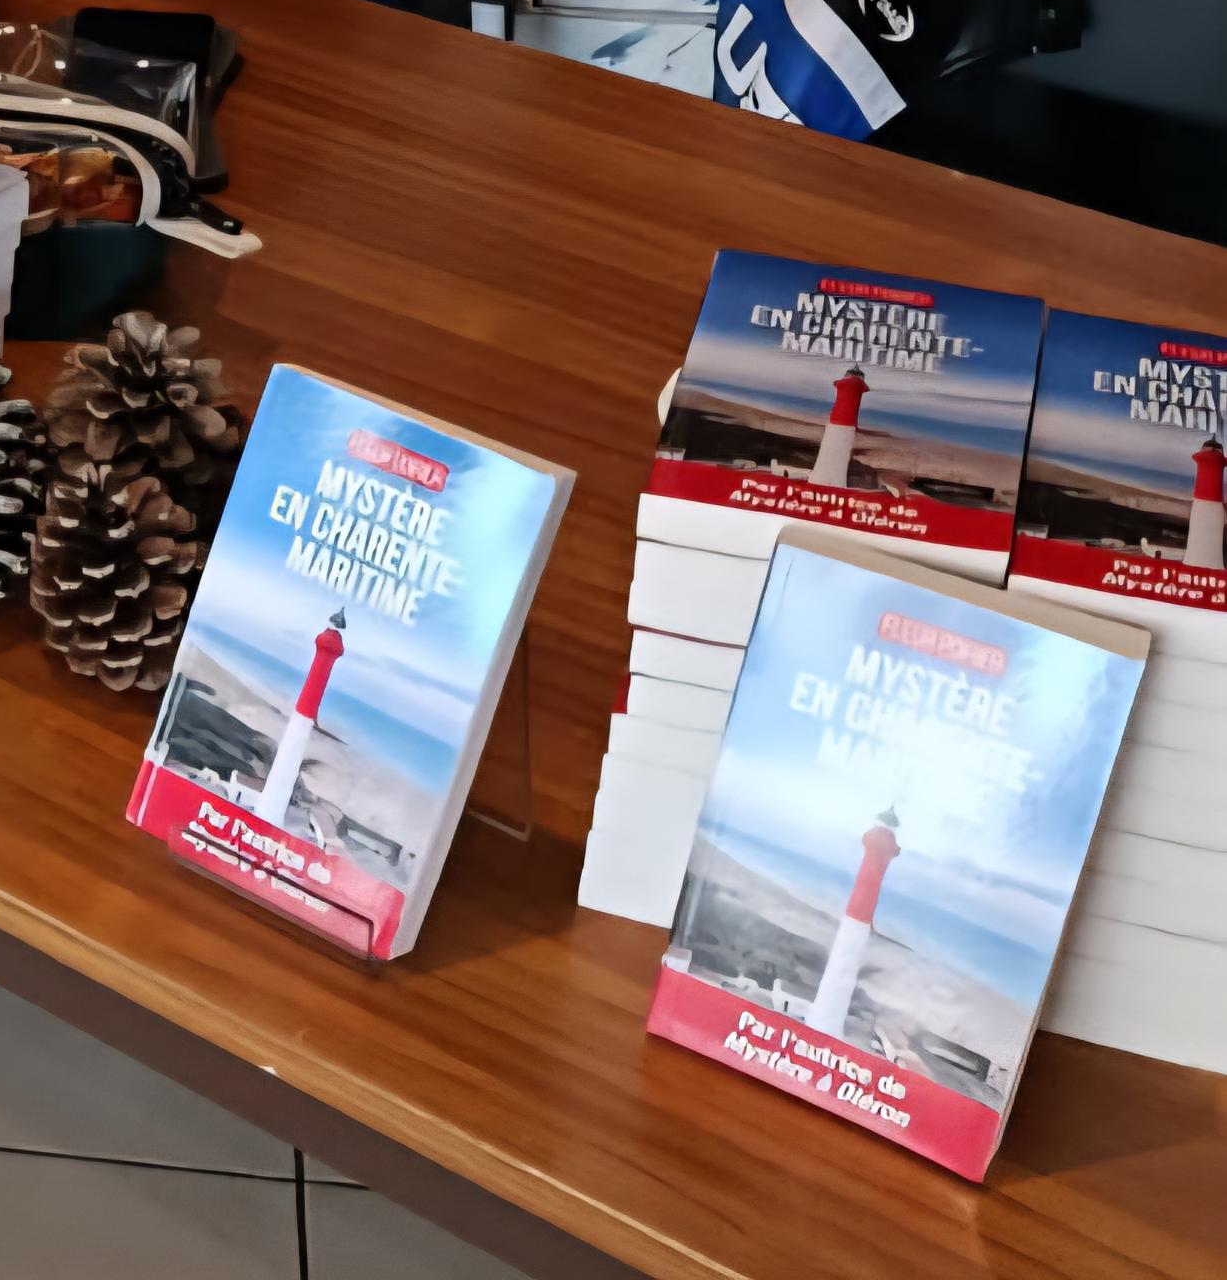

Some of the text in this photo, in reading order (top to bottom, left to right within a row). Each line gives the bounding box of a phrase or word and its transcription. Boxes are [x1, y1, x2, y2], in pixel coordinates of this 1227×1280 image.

[750, 304, 793, 331] EN
[1093, 371, 1136, 396] EN
[269, 484, 311, 532] EN
[315, 458, 453, 547] MYSTÈRE
[742, 478, 778, 493] Par
[285, 535, 425, 625] MARITIME
[1113, 560, 1151, 576] Par
[789, 672, 839, 719] EN
[845, 643, 1017, 735] MYSTÈRE
[738, 1011, 906, 1100] Par l'autrice de
[837, 1081, 911, 1128] Oléron
